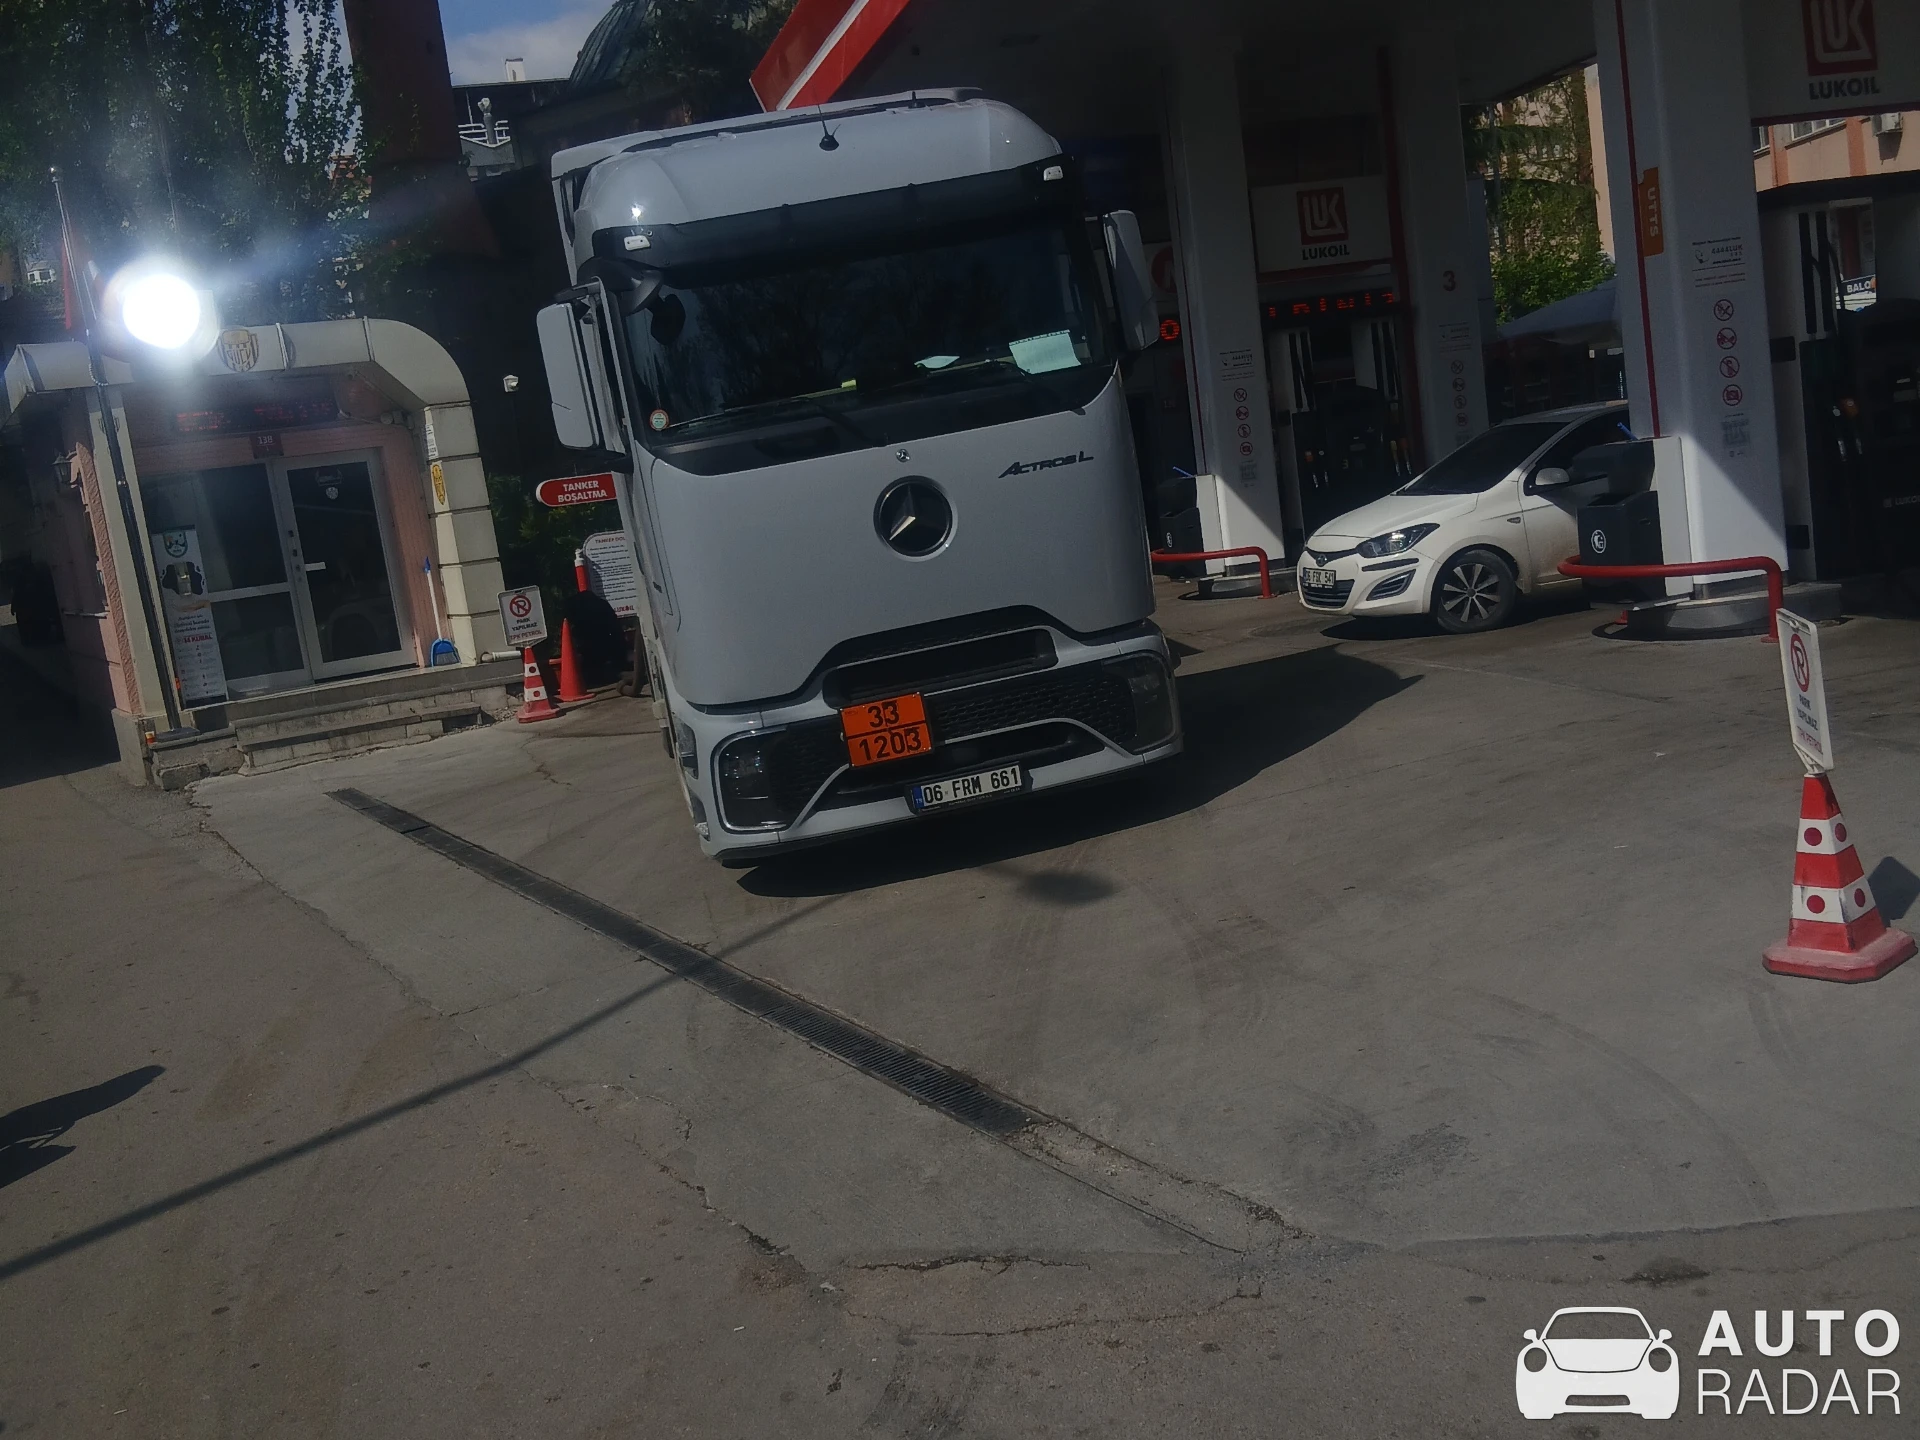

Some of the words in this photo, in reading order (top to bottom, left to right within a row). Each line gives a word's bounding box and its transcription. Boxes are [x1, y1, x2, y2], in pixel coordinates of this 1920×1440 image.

[1808, 76, 1880, 100] LUKOIL
[1302, 192, 1346, 238] LUK
[1647, 186, 1659, 237] UTTS
[1301, 243, 1350, 261] LUKOIL
[1442, 269, 1457, 292] 3
[257, 434, 274, 446] 138
[998, 454, 1077, 479] ACTROS
[557, 489, 608, 503] BOŞALTMA
[562, 480, 600, 492] TANKER
[1894, 494, 1920, 506] LUKO
[511, 622, 538, 632] YAPILMAZ
[516, 617, 531, 625] PARK
[867, 700, 900, 728] 33
[858, 728, 922, 761] 1203
[923, 784, 943, 804] 06
[952, 775, 982, 798] FRM
[990, 767, 1019, 790] 661
